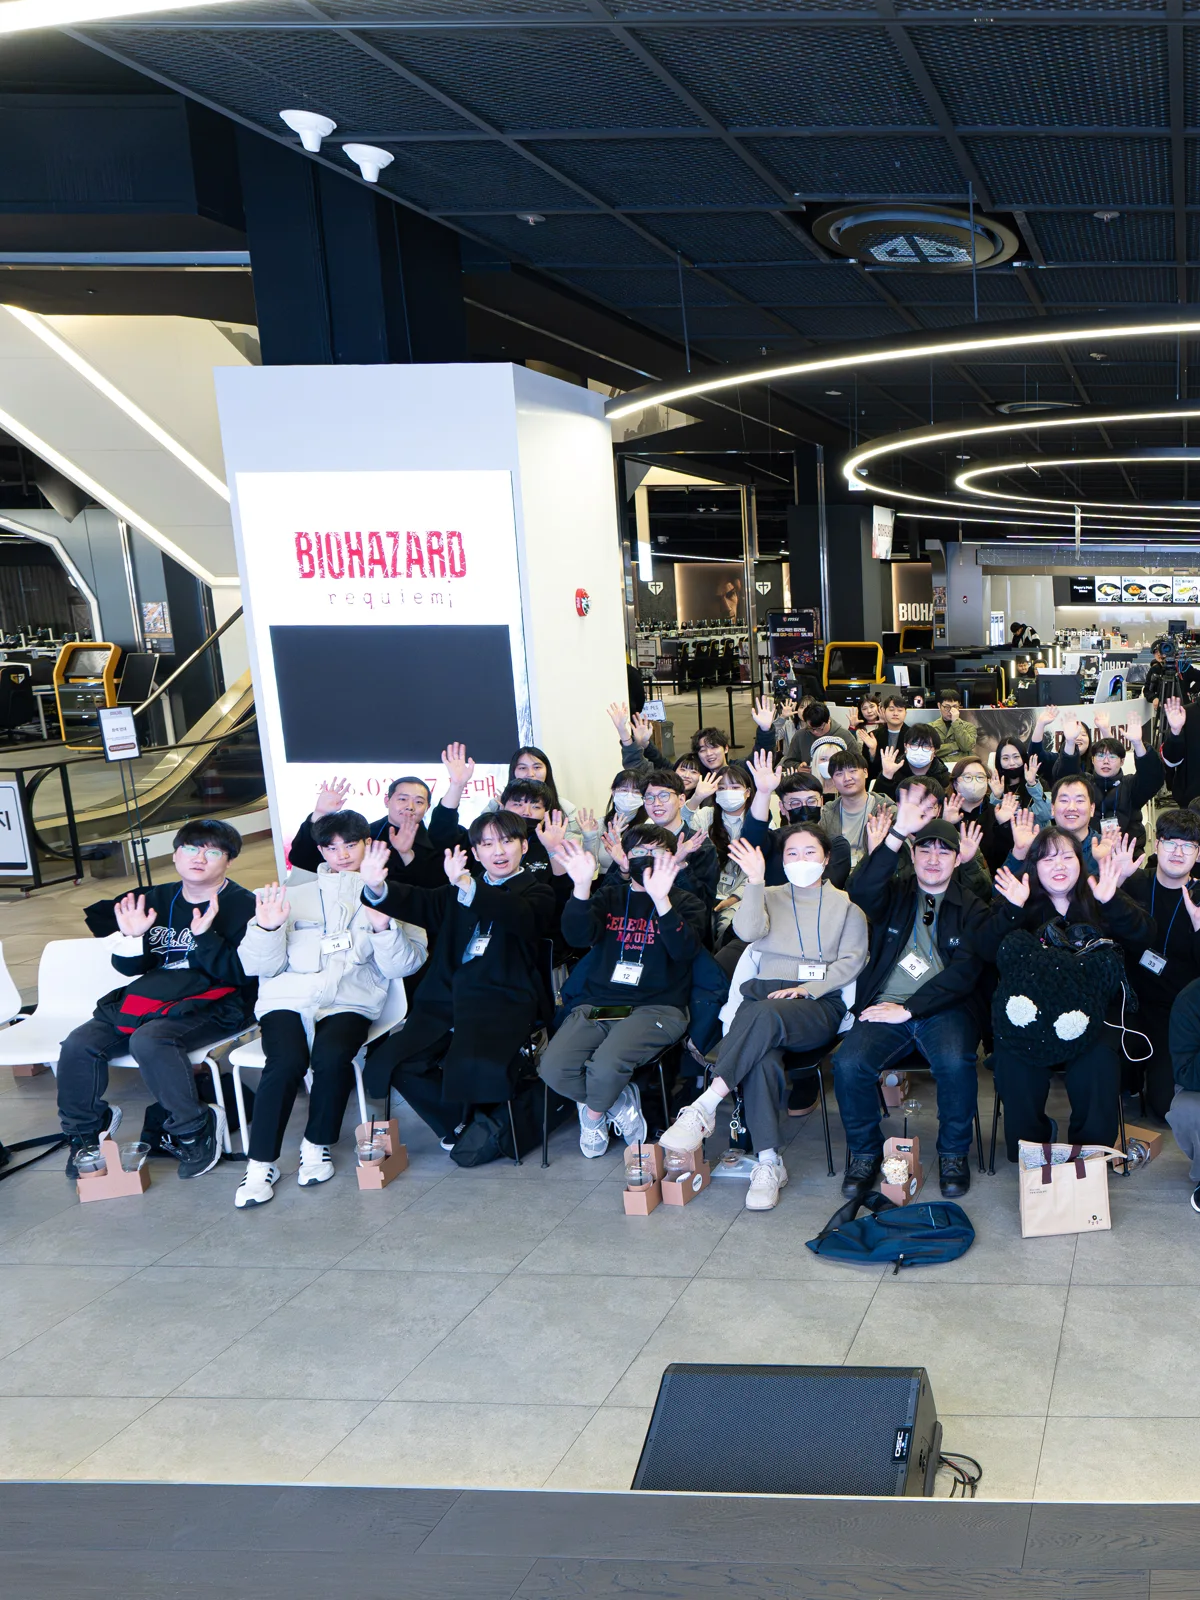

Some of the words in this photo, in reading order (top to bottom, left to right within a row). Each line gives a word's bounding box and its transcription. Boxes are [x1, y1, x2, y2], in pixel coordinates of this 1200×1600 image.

[295, 530, 467, 579] BIOHAZARD
[616, 930, 655, 945] NATURE
[332, 942, 341, 950] 14
[908, 963, 917, 971] 10
[1147, 960, 1156, 968] 33
[894, 1431, 904, 1457] QSC
